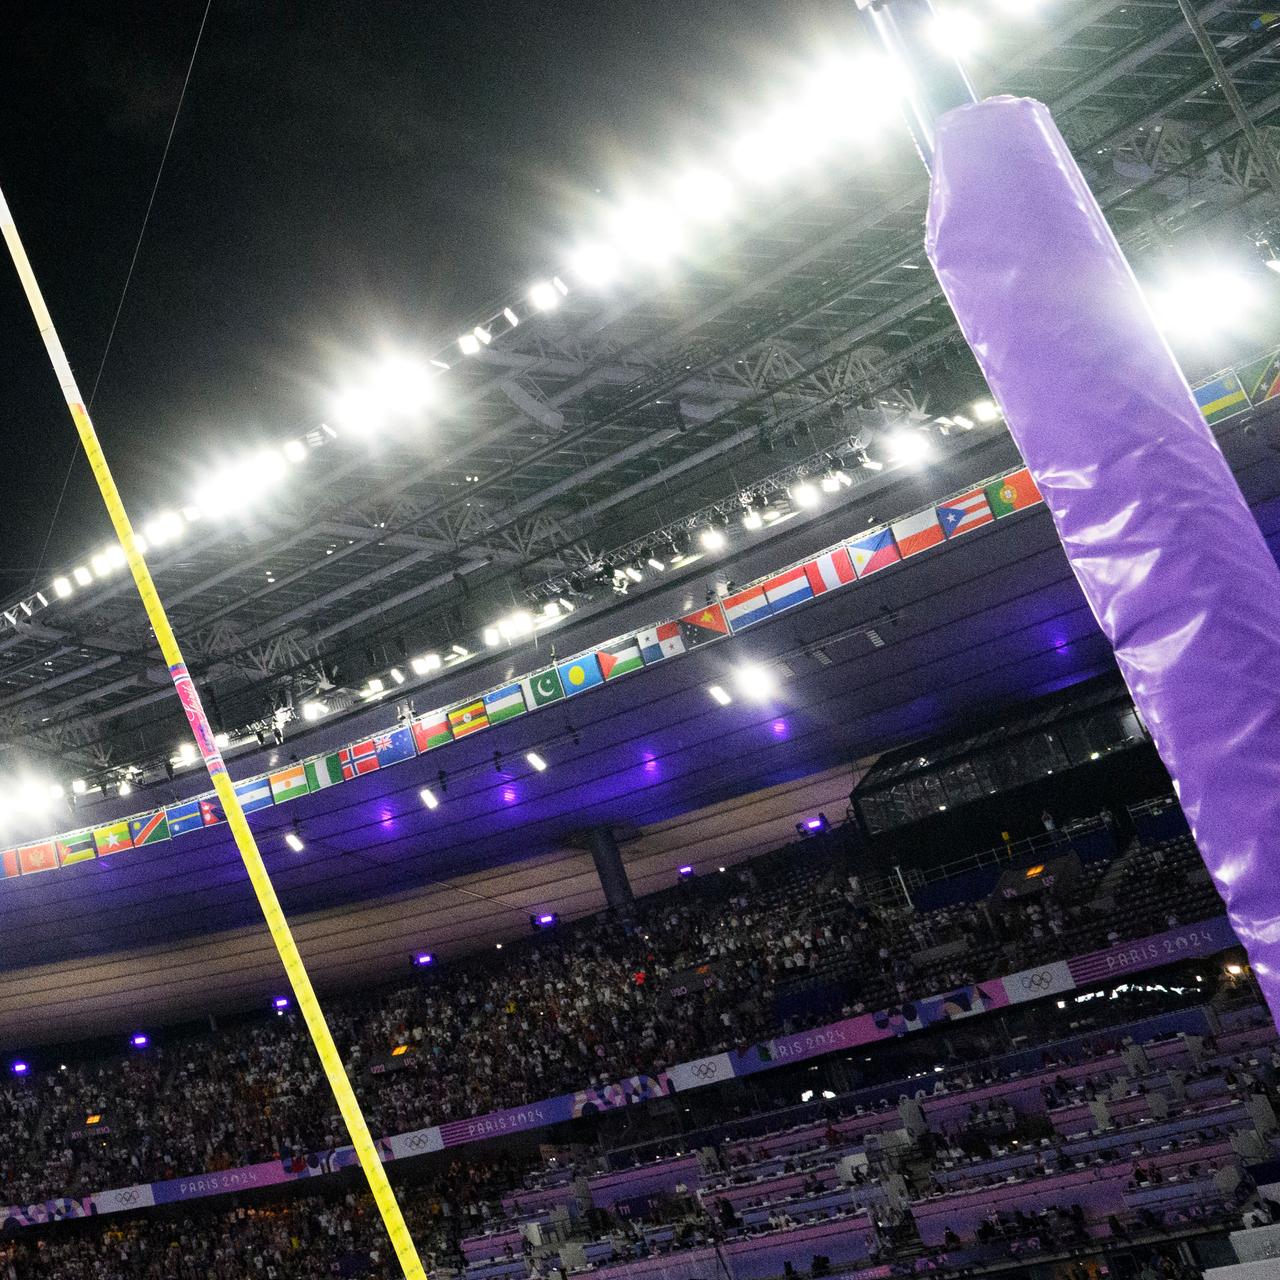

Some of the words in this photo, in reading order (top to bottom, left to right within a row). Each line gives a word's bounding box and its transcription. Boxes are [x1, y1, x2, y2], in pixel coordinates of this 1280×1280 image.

[1106, 944, 1158, 969] PARIS
[1163, 931, 1213, 954] 2024
[806, 1029, 847, 1049] 2024
[468, 1120, 507, 1137] PARIS
[510, 1109, 545, 1128] 2024
[180, 1177, 219, 1195] PARIS
[222, 1171, 258, 1189] 2024
